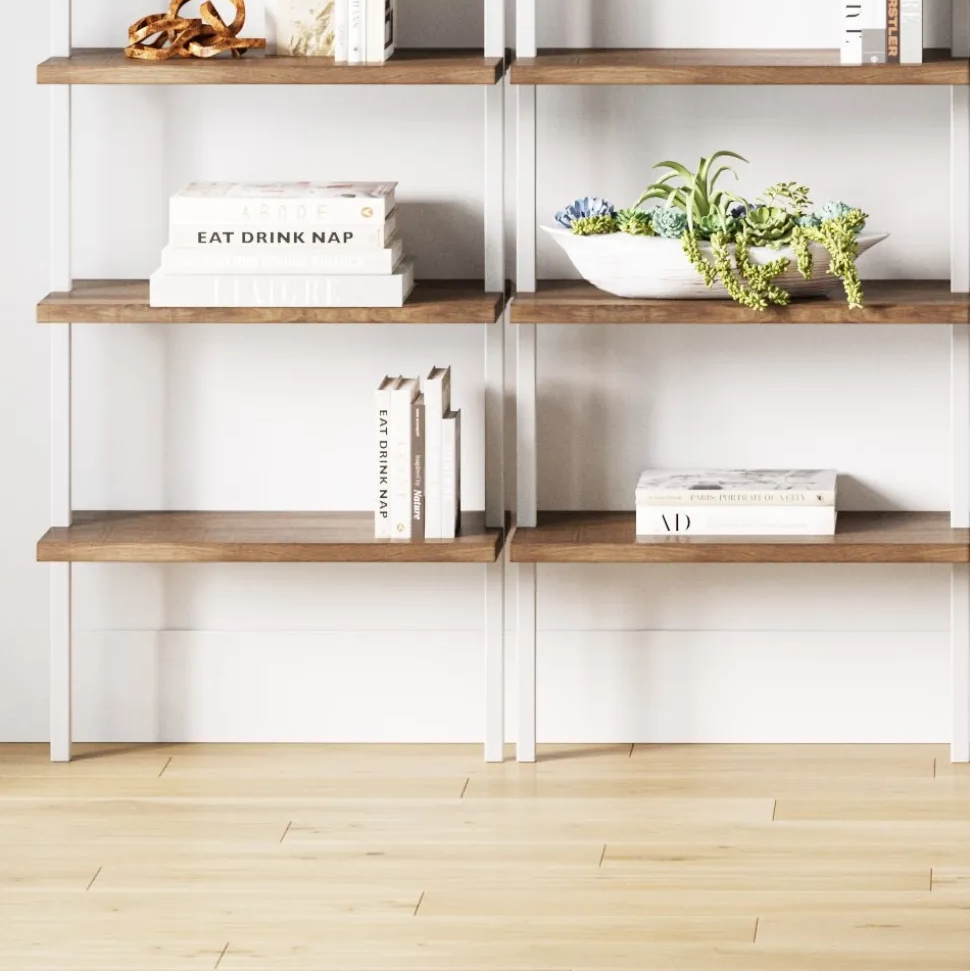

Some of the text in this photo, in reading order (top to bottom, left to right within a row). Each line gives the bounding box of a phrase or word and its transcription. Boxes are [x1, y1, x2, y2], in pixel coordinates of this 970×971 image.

[197, 231, 354, 244] EAT DRINK NAP
[379, 410, 388, 519] EAT DRINK NAP
[413, 489, 422, 520] Nature
